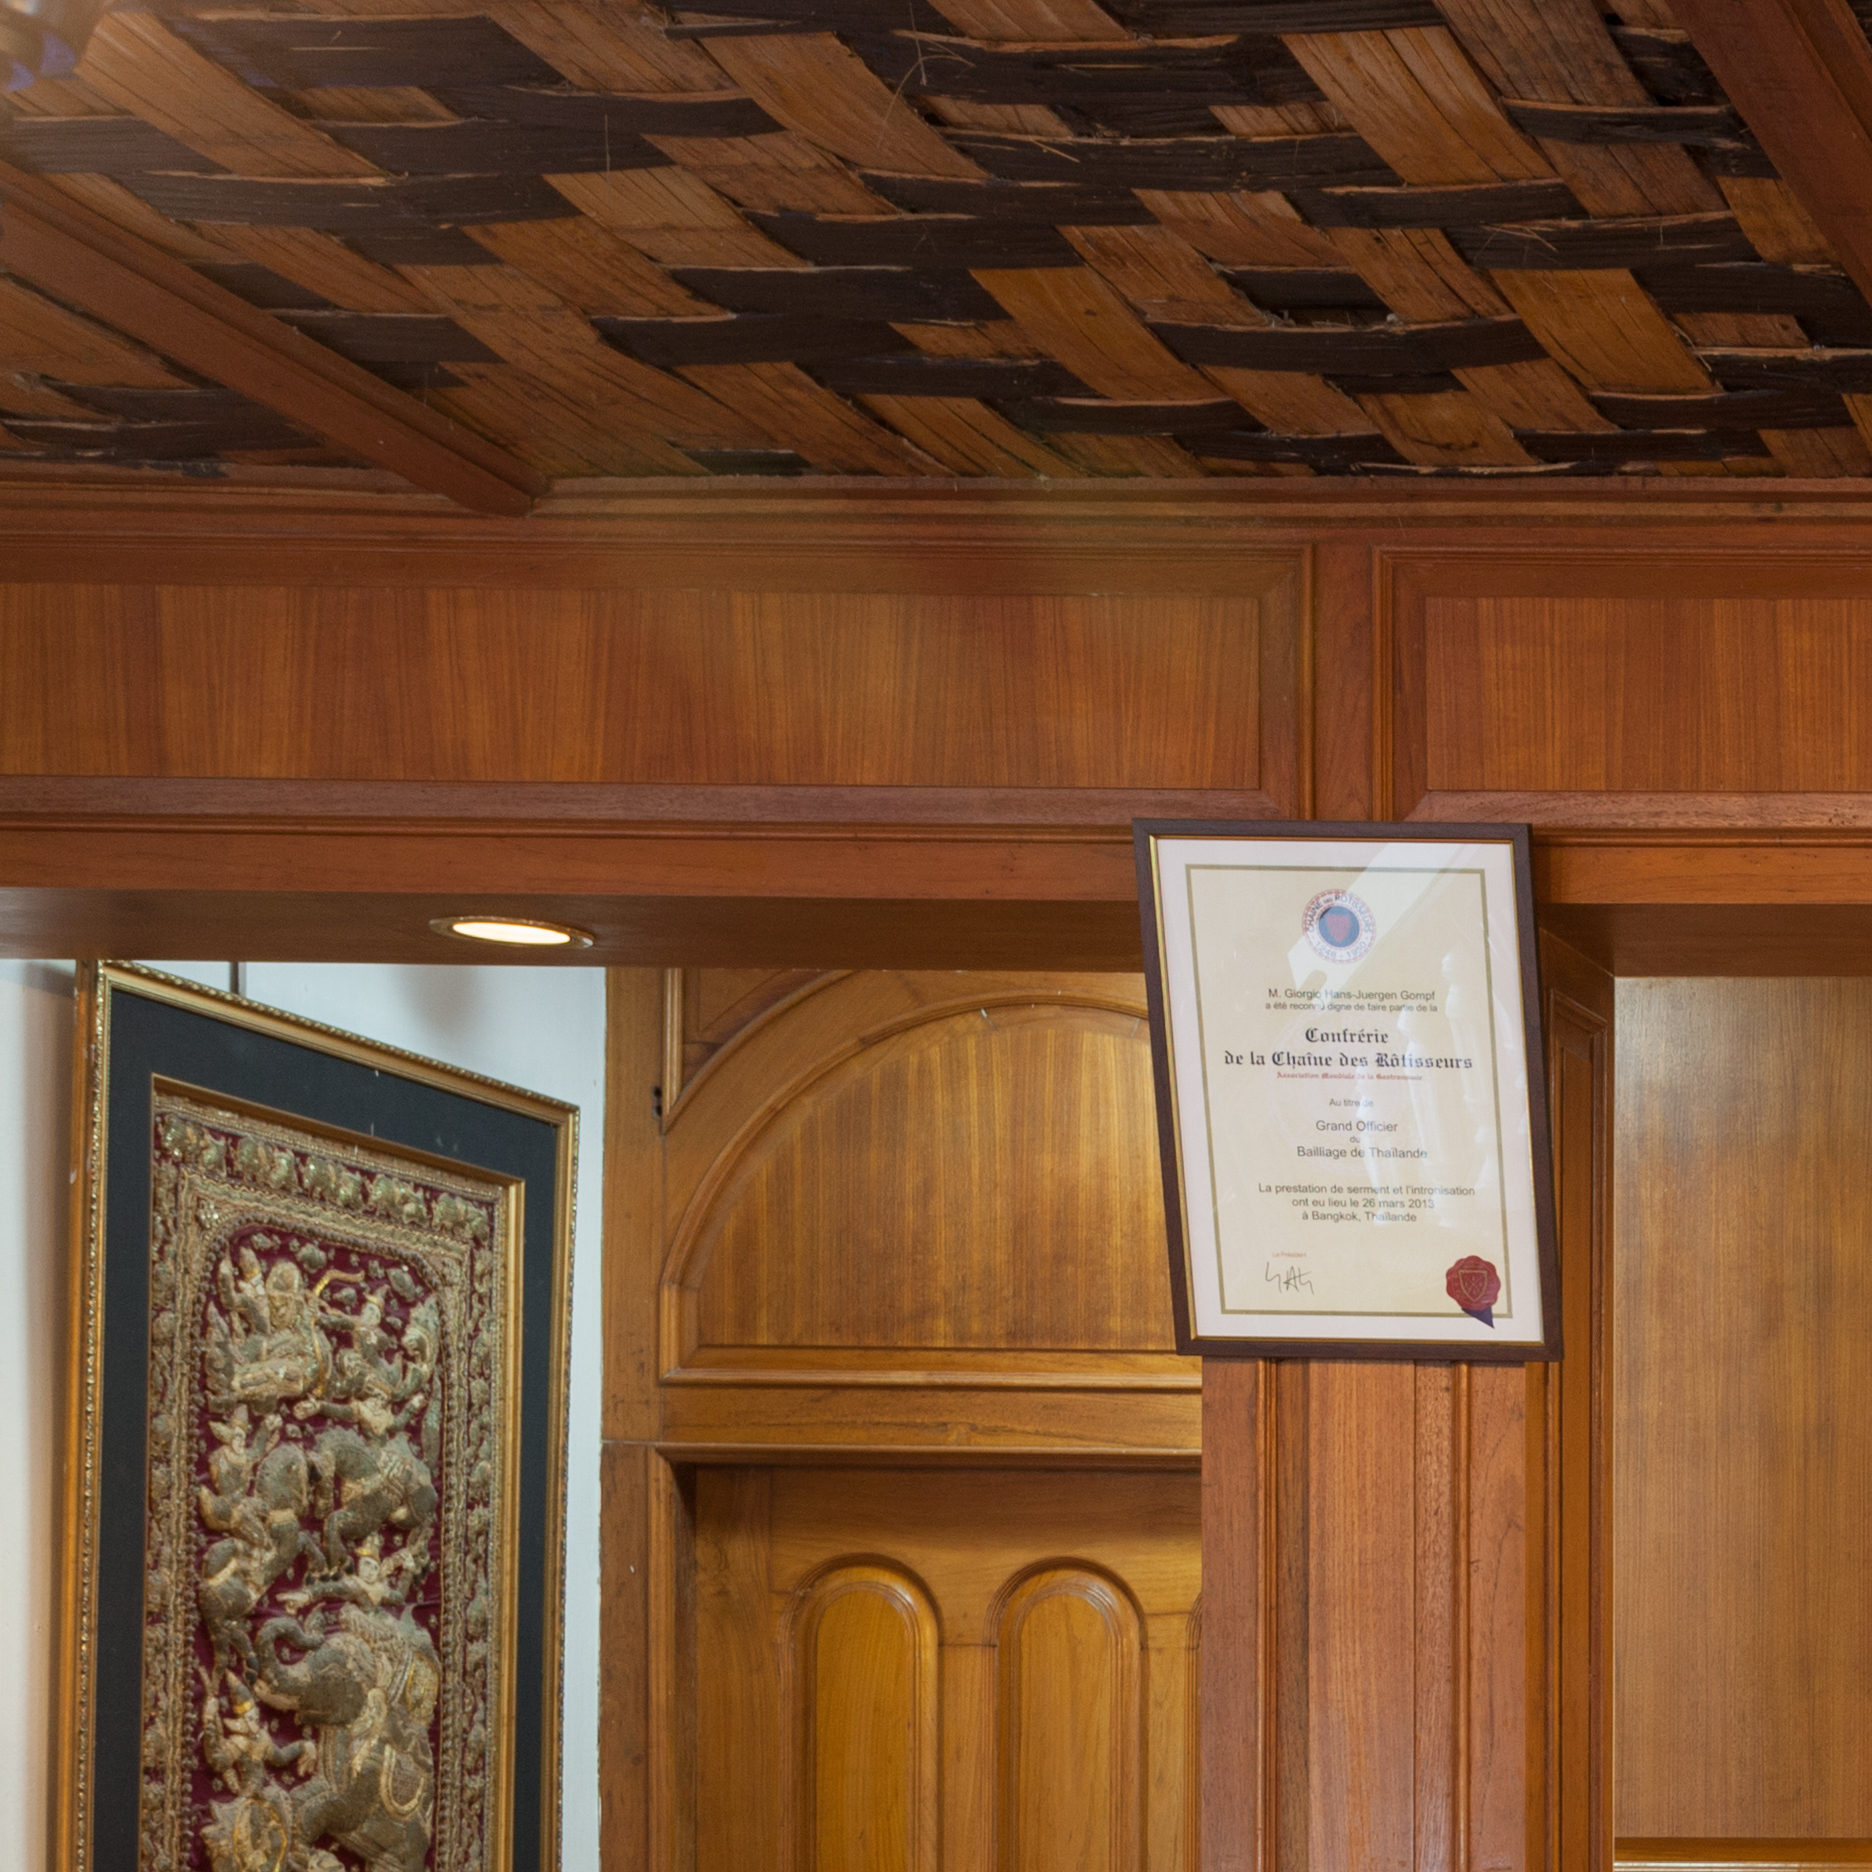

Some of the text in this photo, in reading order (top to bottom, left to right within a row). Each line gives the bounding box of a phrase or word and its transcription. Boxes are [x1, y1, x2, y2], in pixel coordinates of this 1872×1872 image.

[1305, 1027, 1389, 1044] Confrérie
[1224, 1050, 1473, 1069] de la Chaîne des Rôtisseurs
